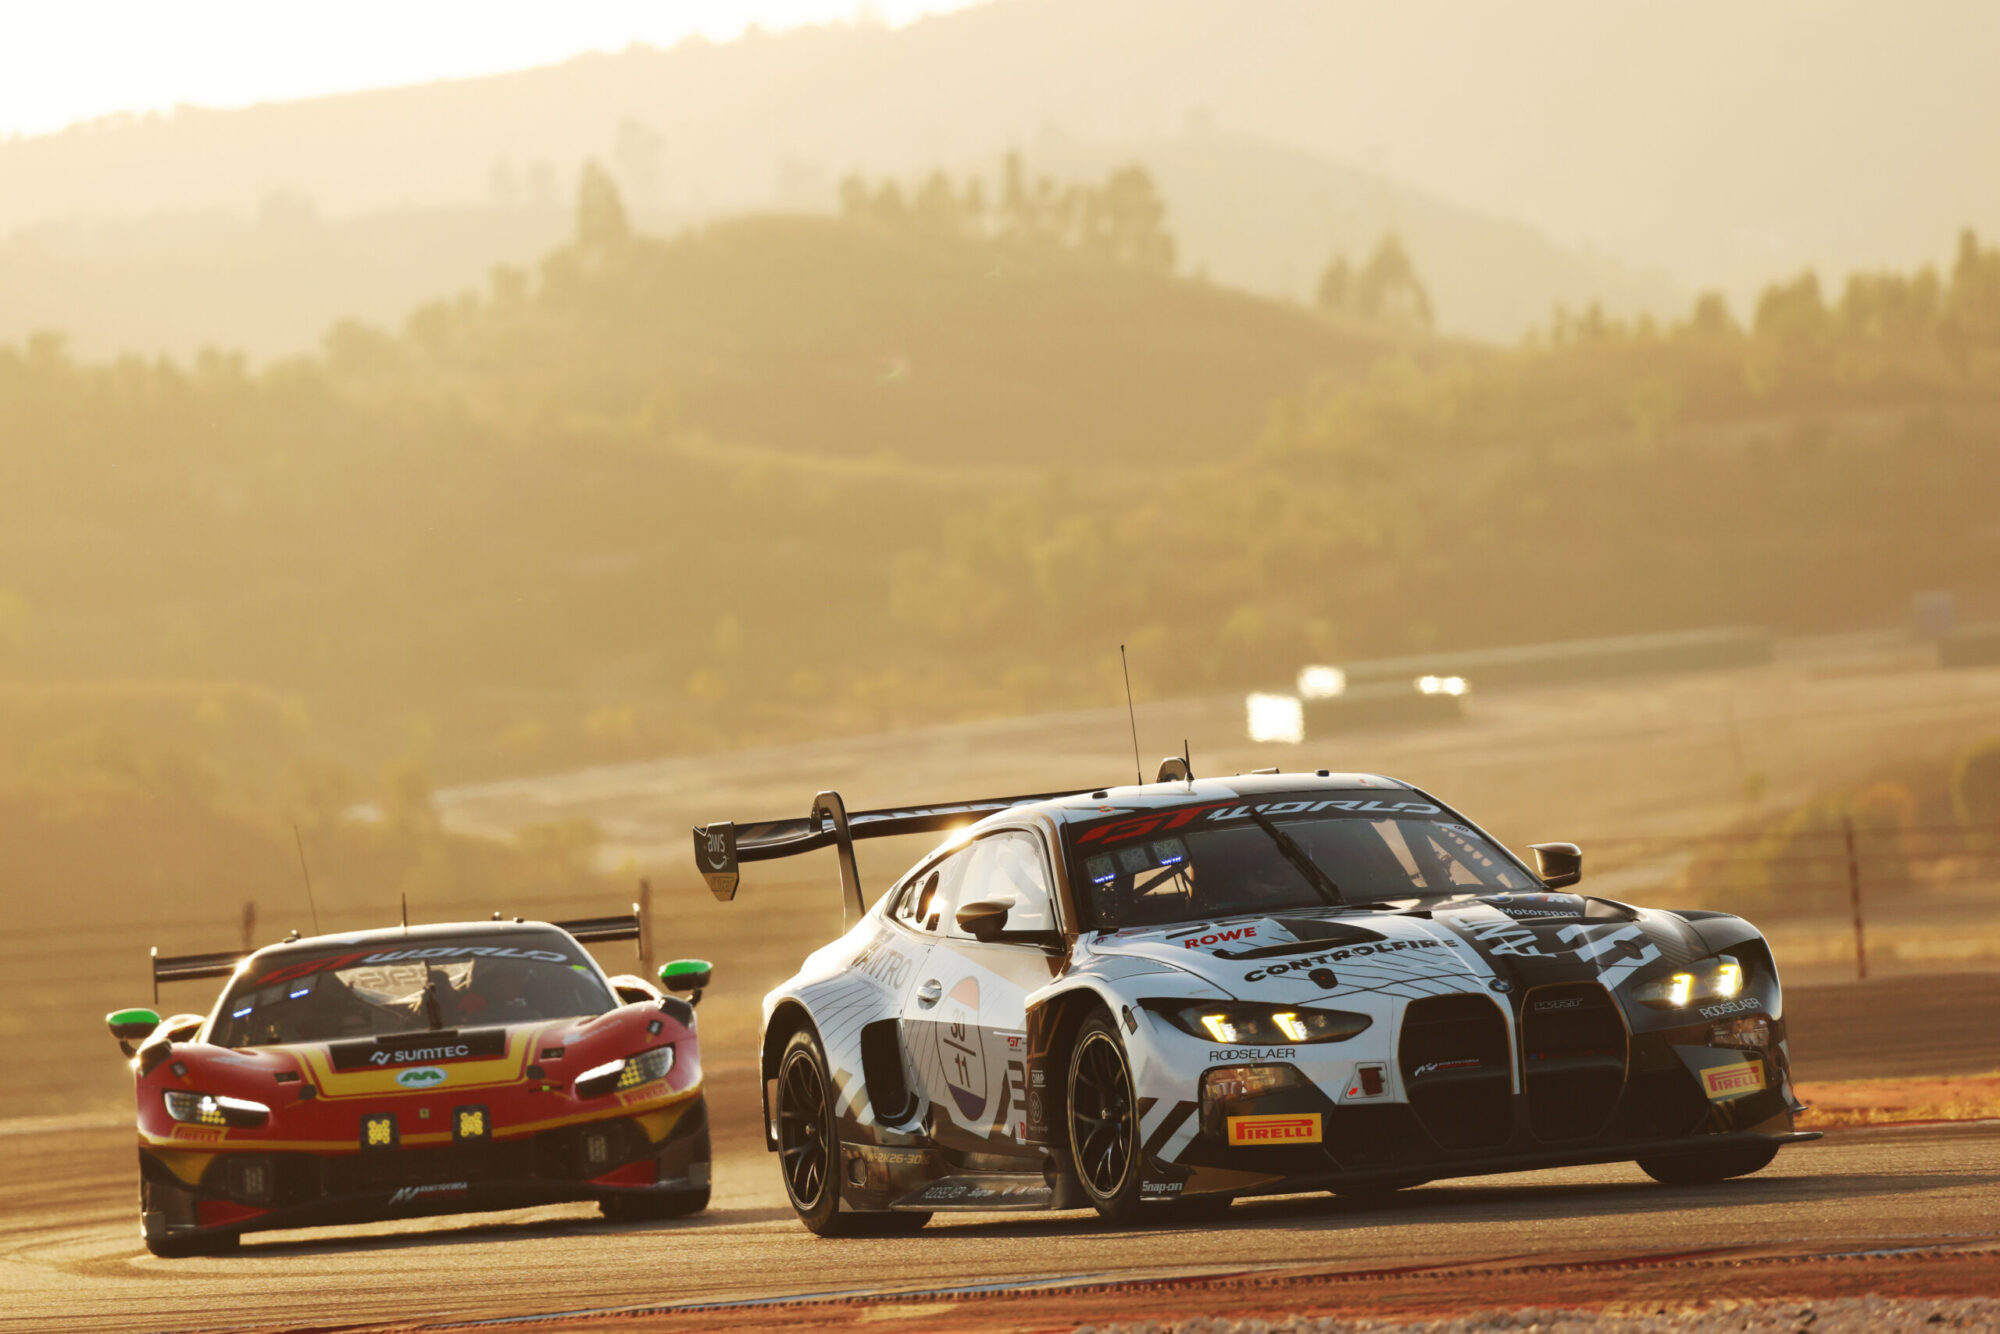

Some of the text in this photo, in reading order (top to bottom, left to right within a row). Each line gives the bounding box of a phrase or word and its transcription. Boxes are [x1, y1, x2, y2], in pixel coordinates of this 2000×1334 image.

[1206, 801, 1441, 821] WORLD
[706, 833, 726, 853] aws
[1499, 907, 1582, 918] Motorsport
[1184, 926, 1258, 949] ROWE
[1244, 939, 1459, 983] CONTROLFIRE
[1699, 997, 1762, 1018] ROOSELAER
[394, 1045, 469, 1062] SUMTEC
[1209, 1048, 1296, 1062] ROOSELAER
[1707, 1065, 1760, 1092] PIRELLI
[1236, 1119, 1313, 1140] PIRELLI
[1142, 1180, 1183, 1194] Snap-on
